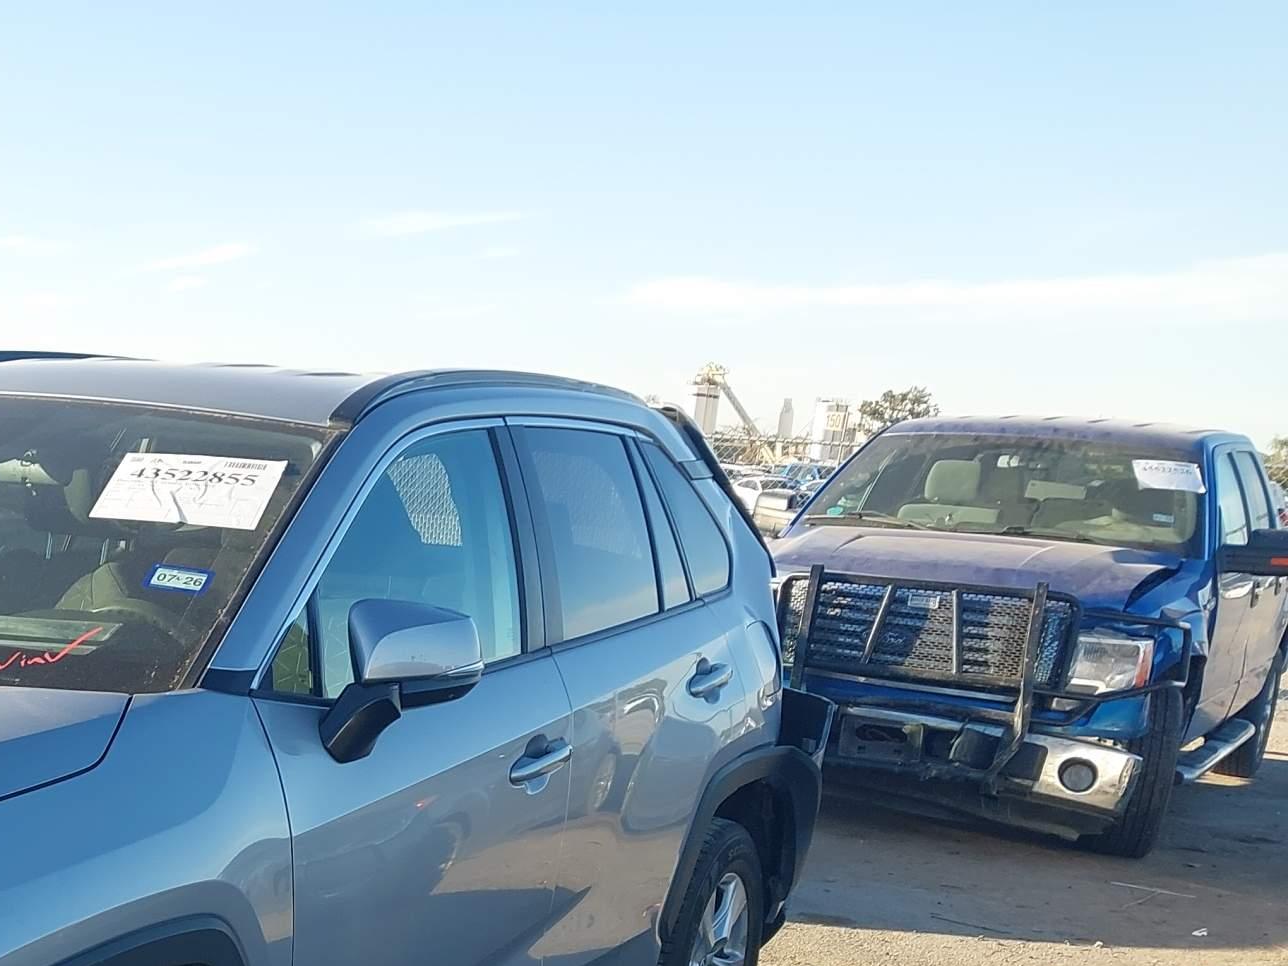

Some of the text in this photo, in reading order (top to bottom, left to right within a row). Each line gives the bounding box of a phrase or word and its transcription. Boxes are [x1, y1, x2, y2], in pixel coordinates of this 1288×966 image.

[826, 413, 841, 428] 150
[130, 467, 259, 487] 43522855
[156, 572, 204, 587] 07 26
